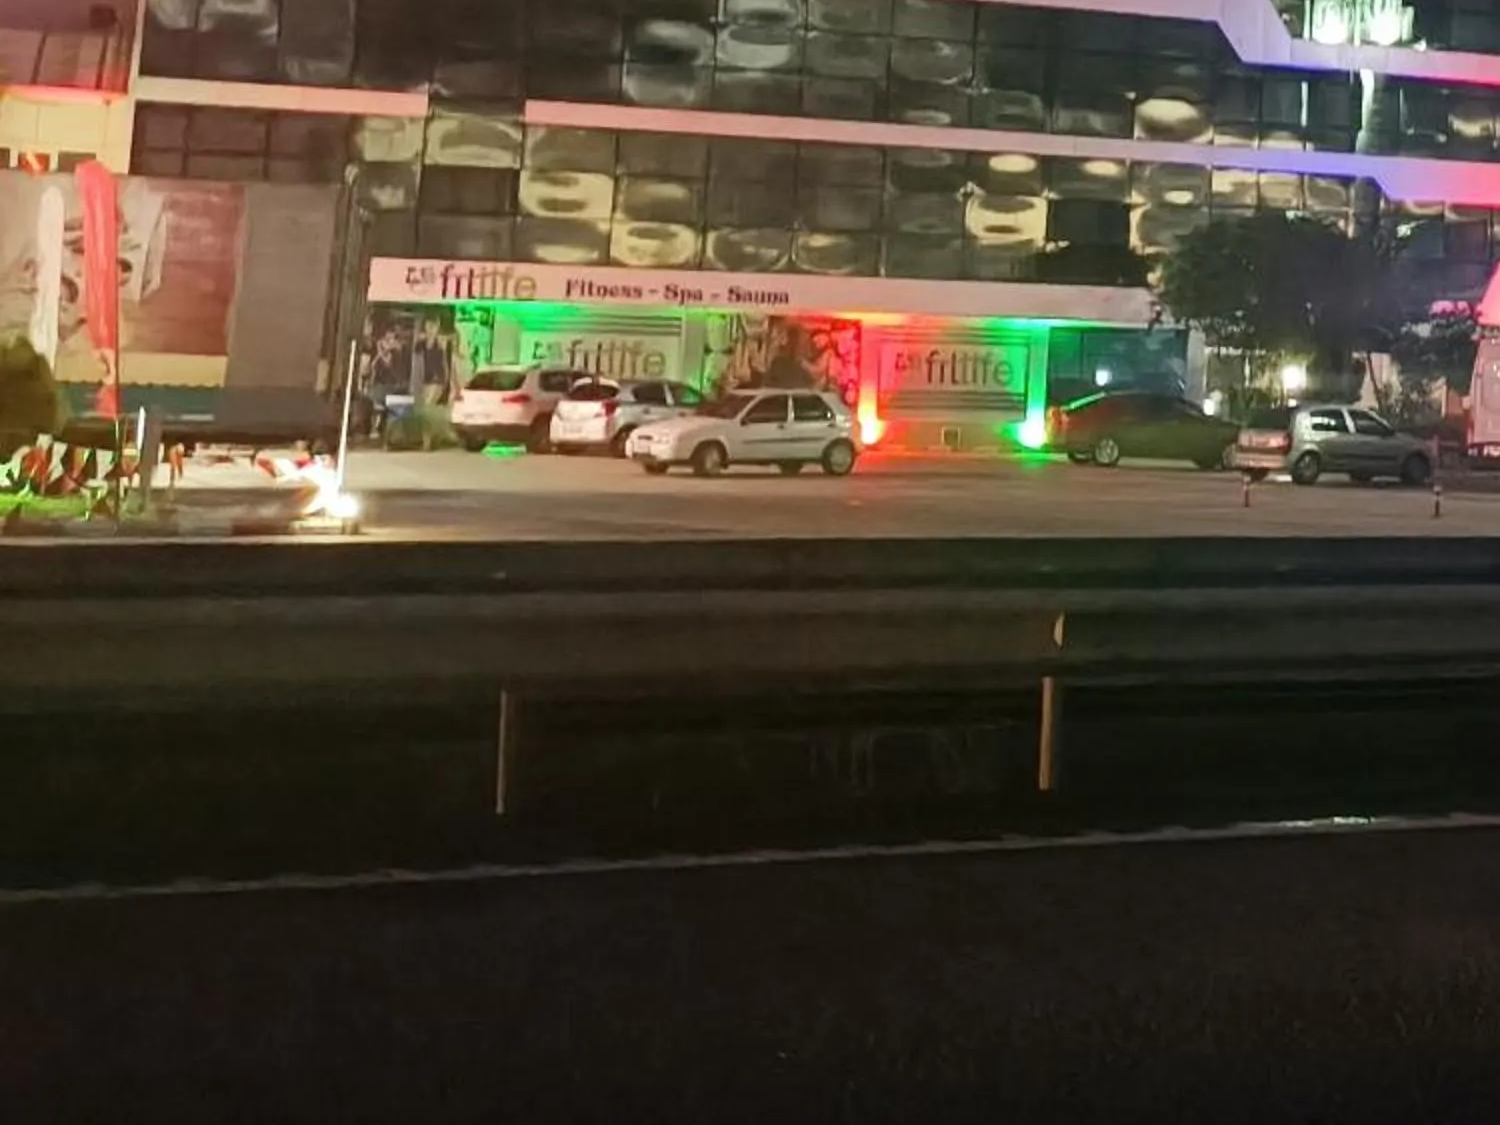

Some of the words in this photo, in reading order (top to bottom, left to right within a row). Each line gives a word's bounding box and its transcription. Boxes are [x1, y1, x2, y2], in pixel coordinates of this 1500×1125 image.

[565, 278, 643, 300] Fitness
[664, 283, 703, 306] Spa
[727, 285, 790, 306] Sauna
